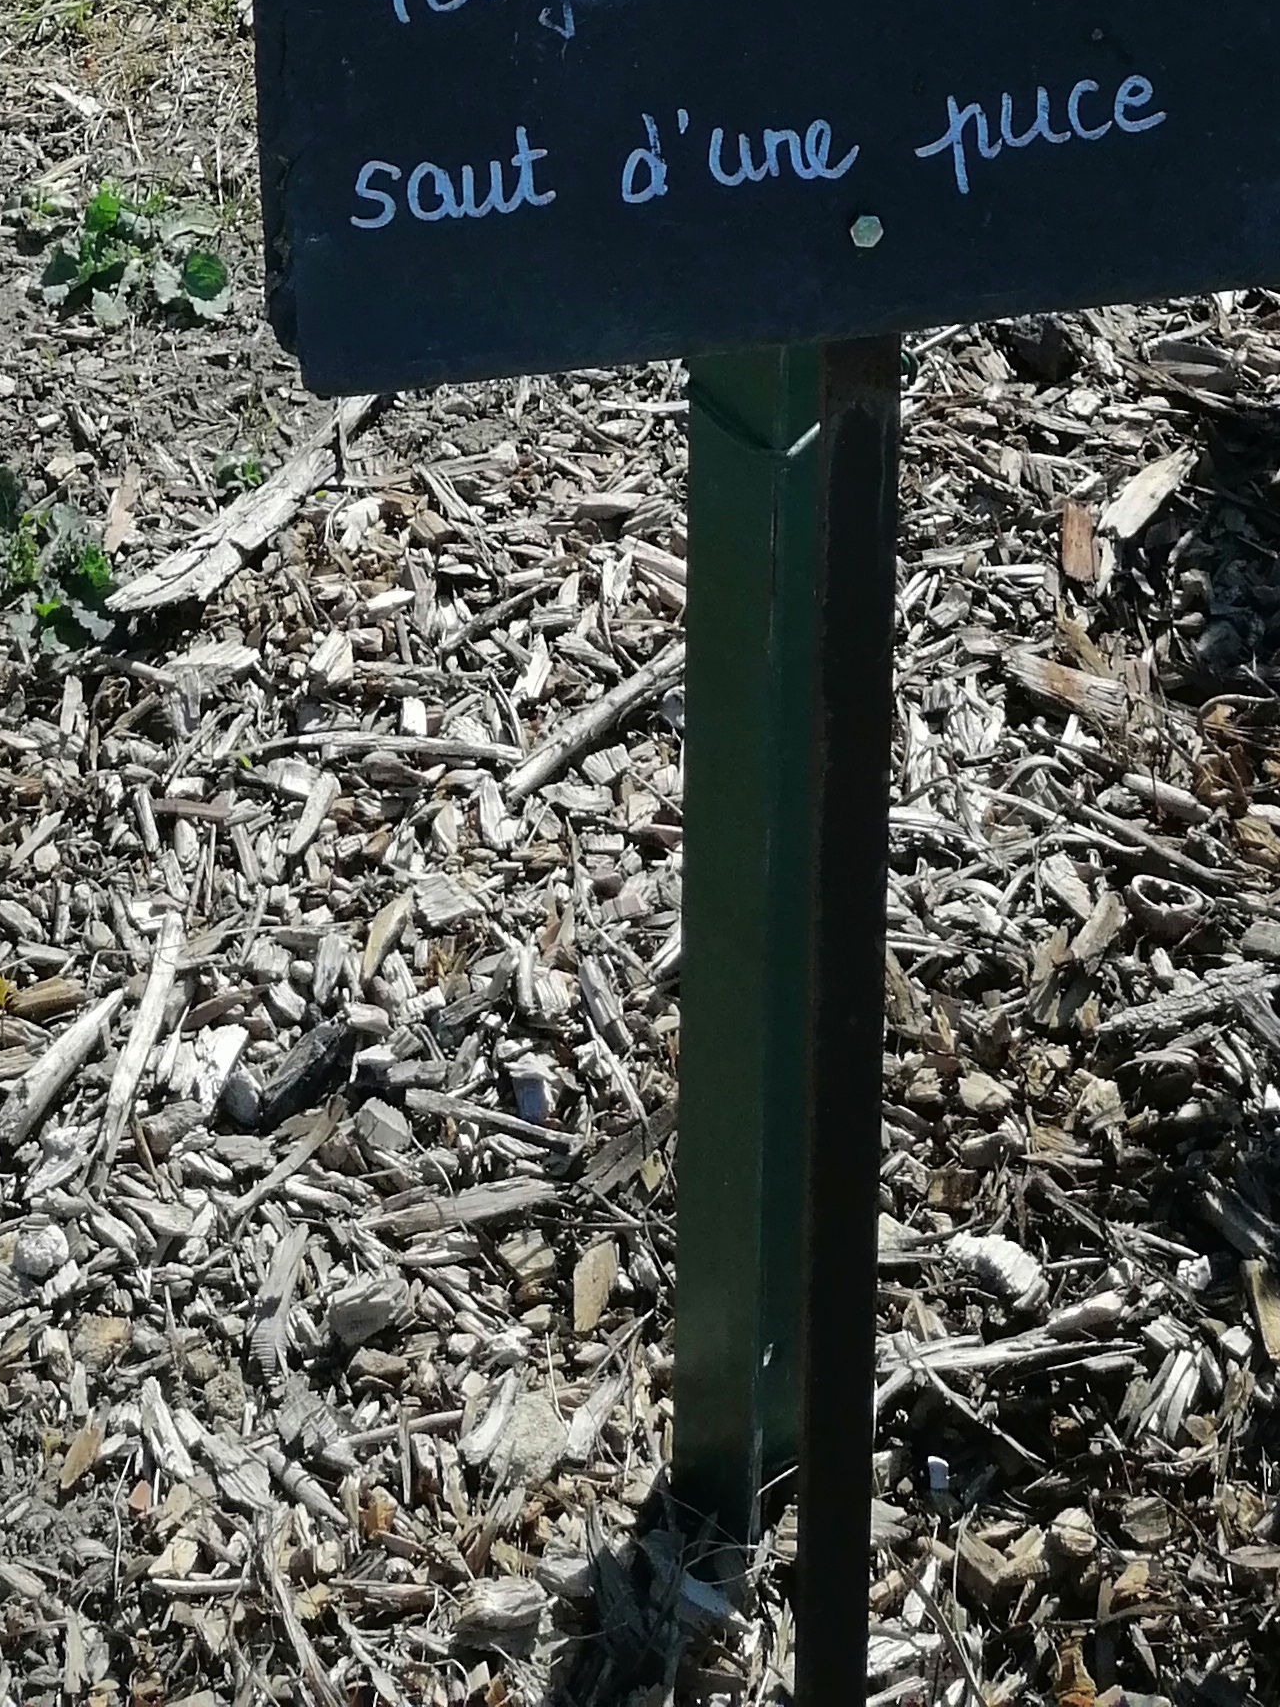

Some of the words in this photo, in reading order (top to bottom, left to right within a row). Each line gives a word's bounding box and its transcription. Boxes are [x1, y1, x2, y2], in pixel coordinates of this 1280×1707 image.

[349, 125, 559, 231] saut
[620, 106, 860, 206] d'une
[915, 70, 1168, 195] puce
